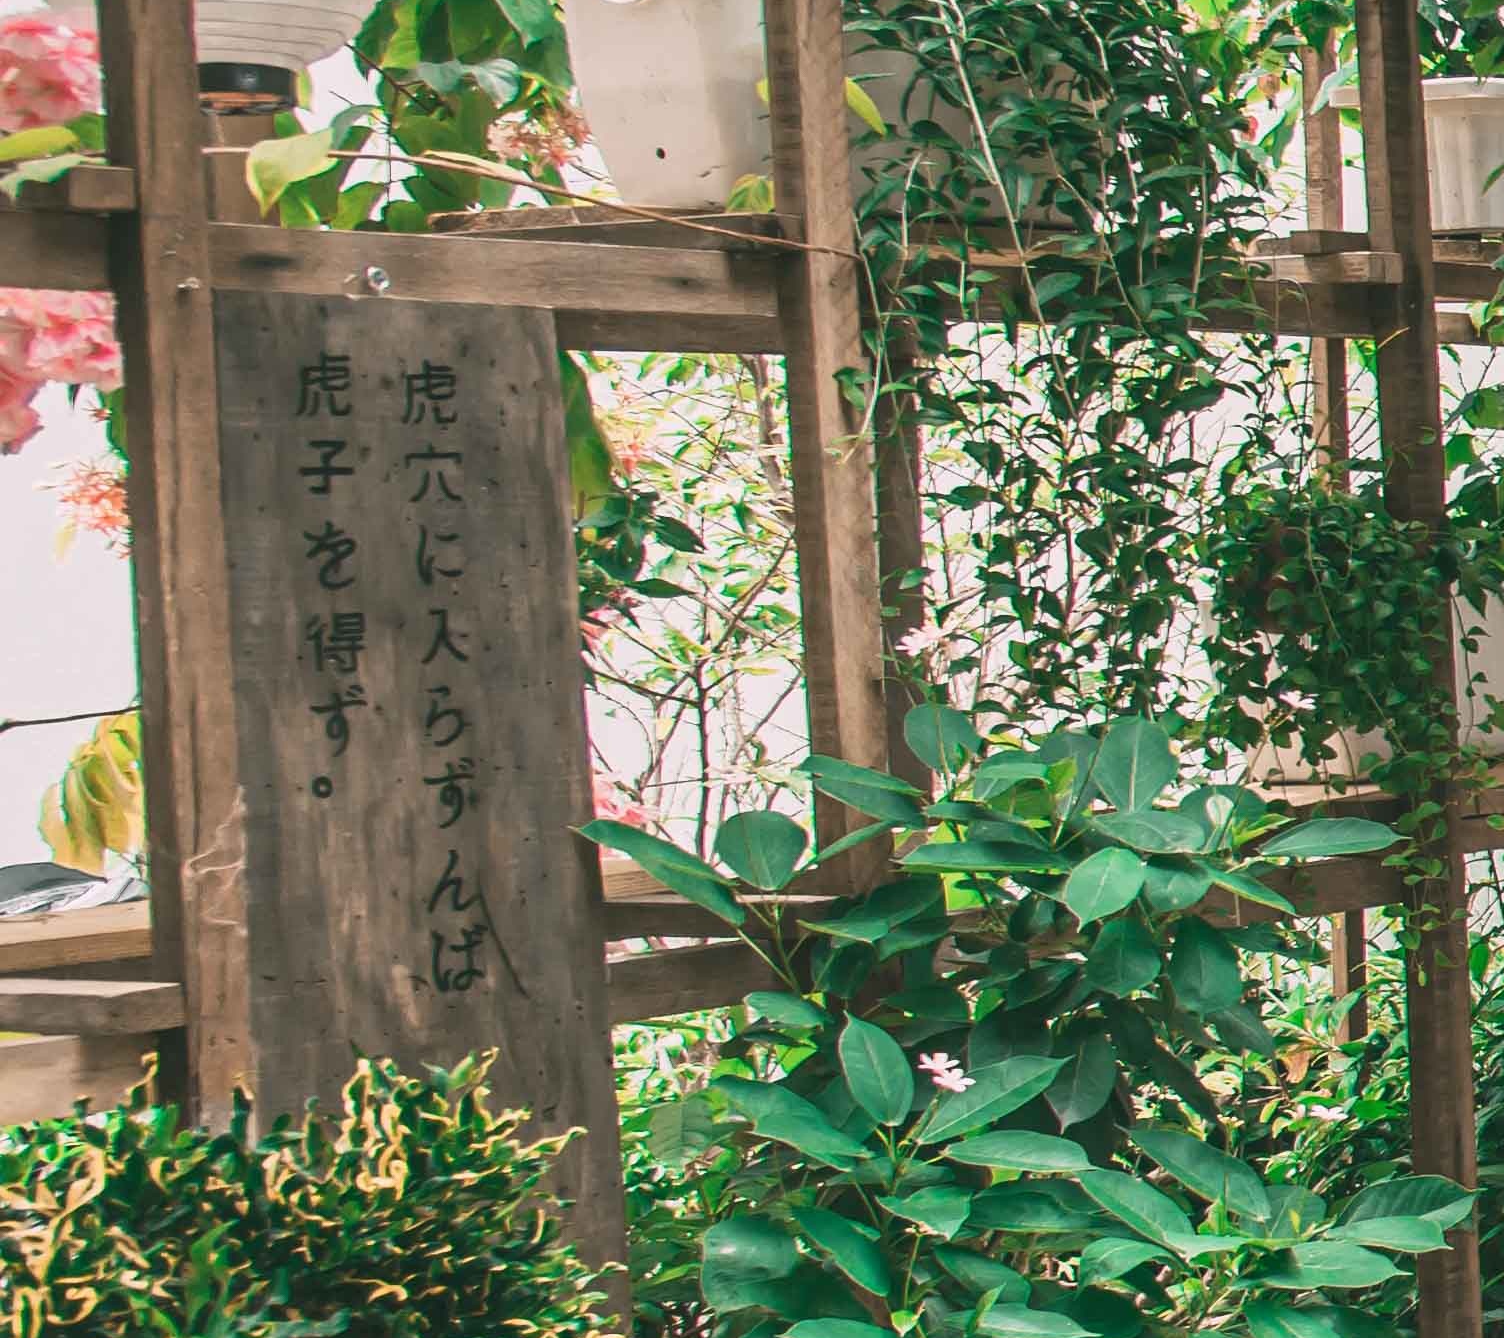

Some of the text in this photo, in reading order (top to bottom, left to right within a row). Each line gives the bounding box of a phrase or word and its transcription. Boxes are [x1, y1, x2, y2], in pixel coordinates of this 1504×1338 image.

[297, 352, 369, 801] 虎子を得ず。
[400, 360, 488, 993] 虎穴に入らずんば
